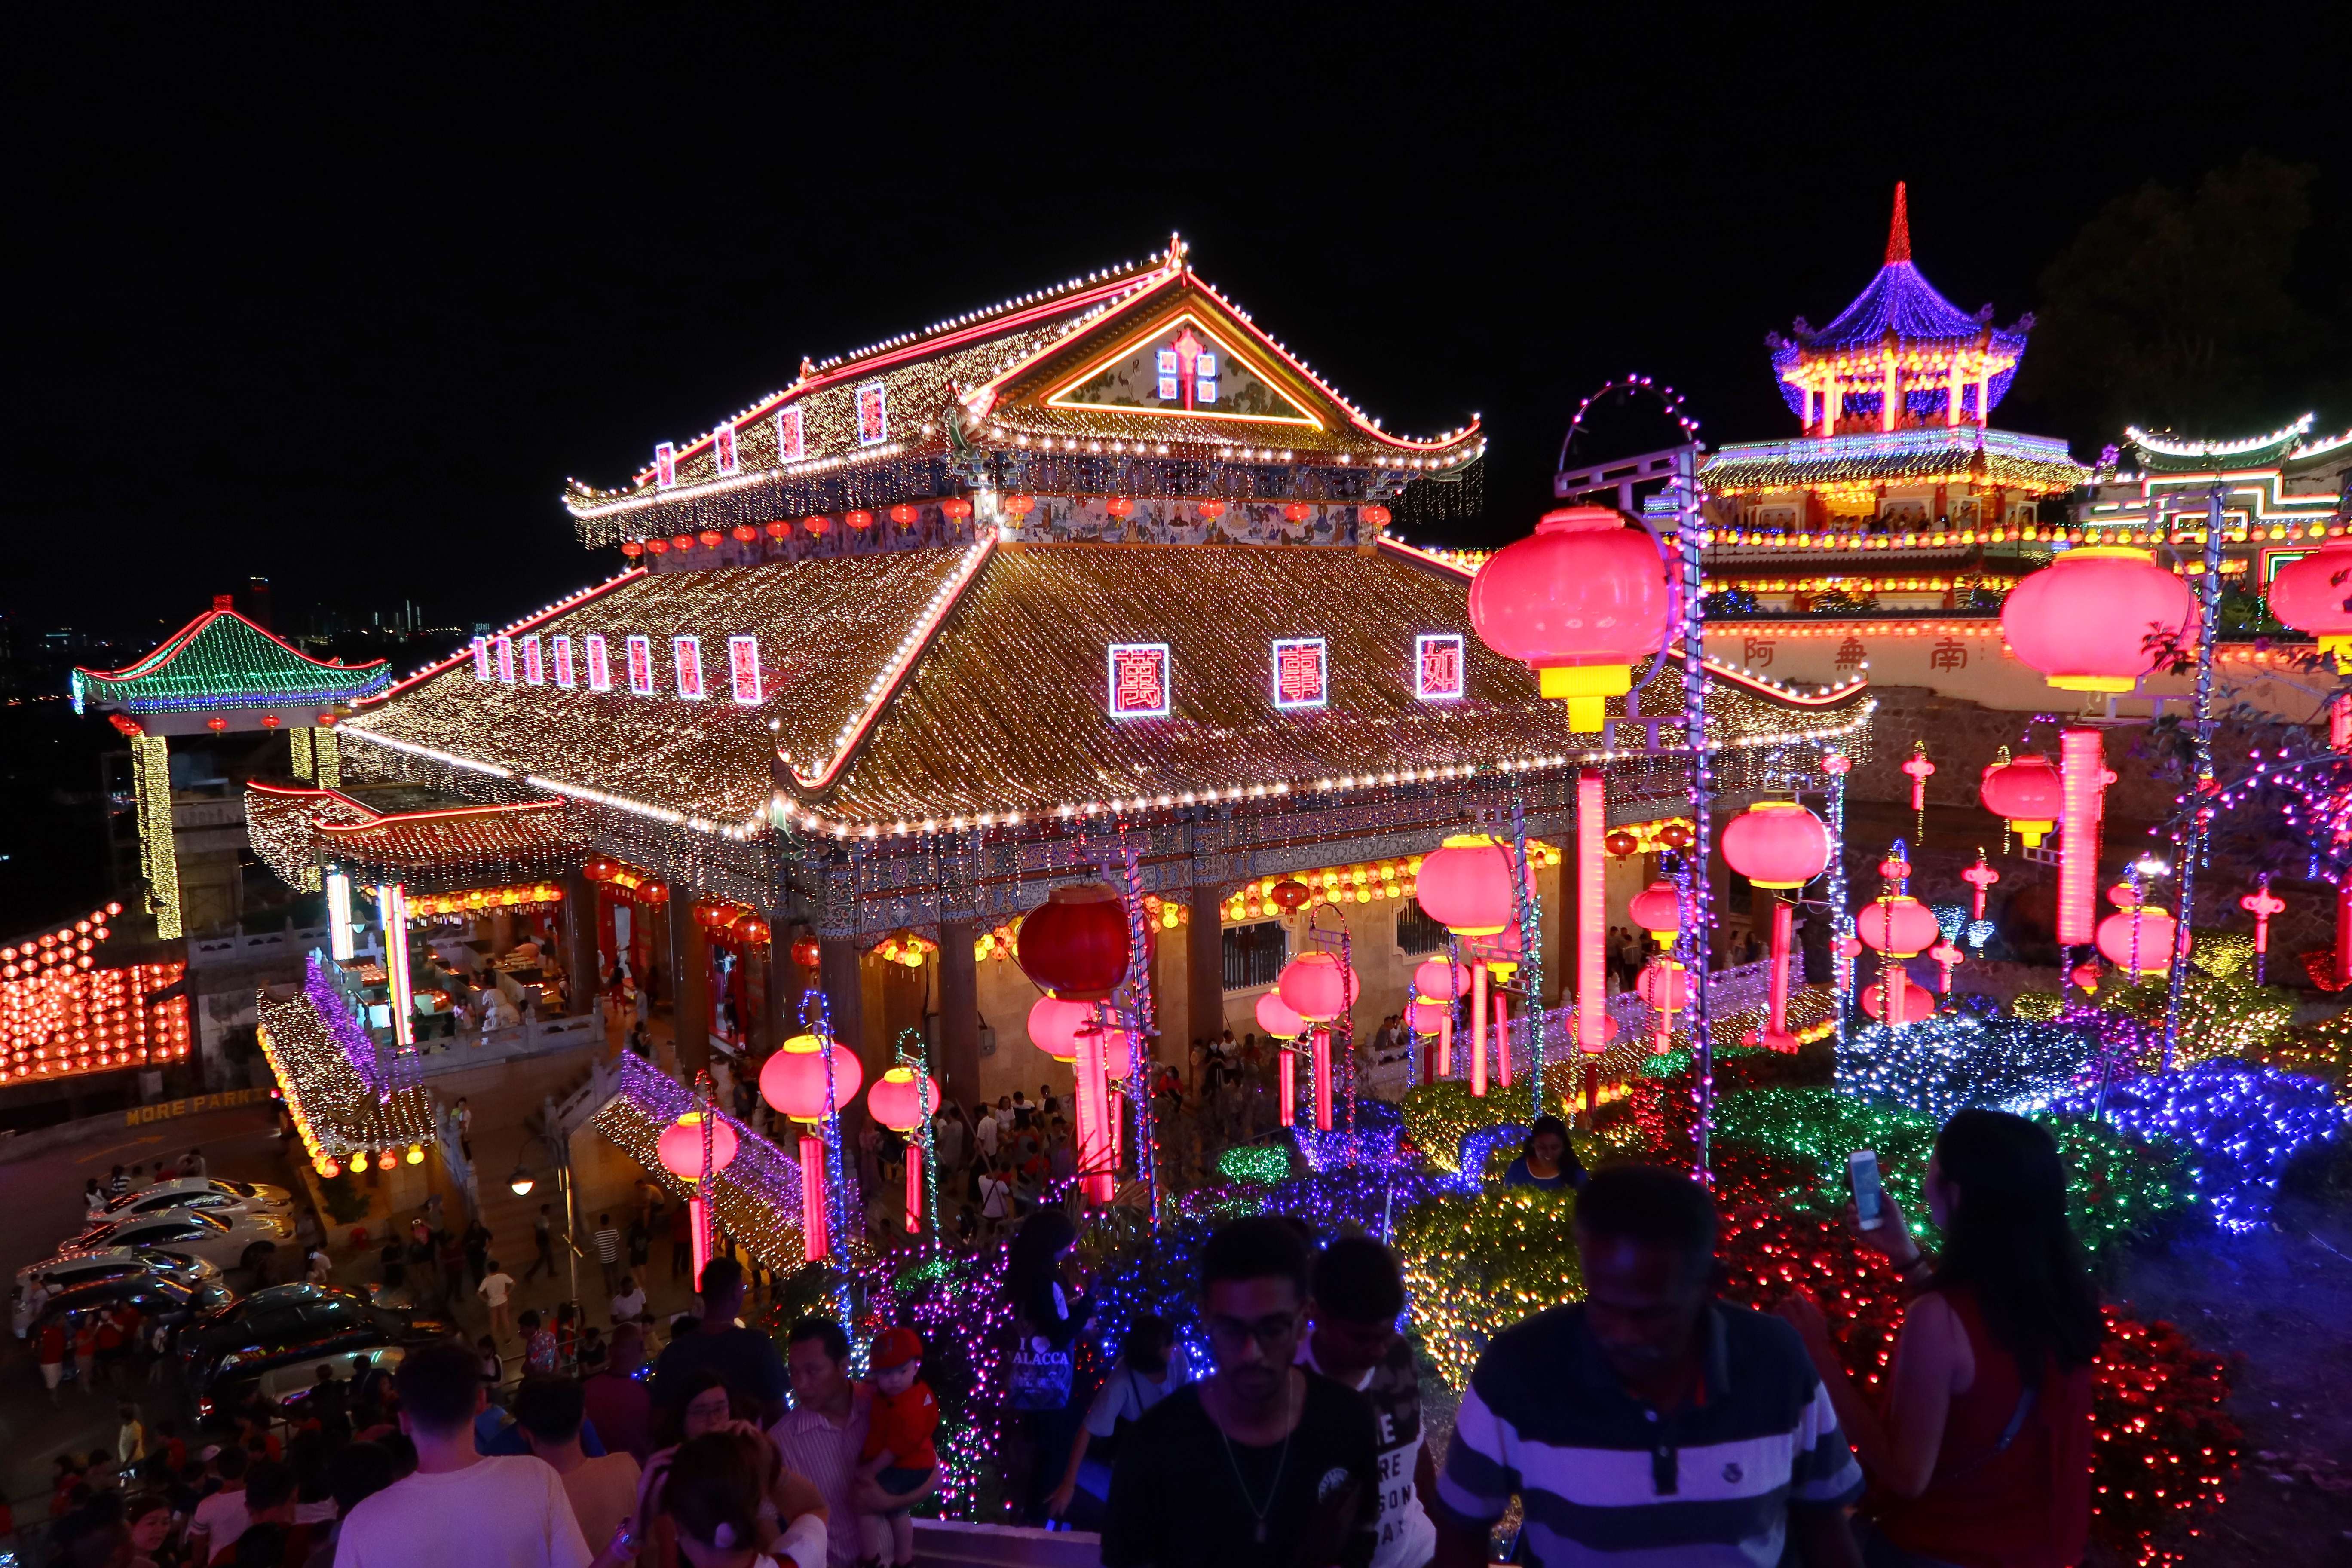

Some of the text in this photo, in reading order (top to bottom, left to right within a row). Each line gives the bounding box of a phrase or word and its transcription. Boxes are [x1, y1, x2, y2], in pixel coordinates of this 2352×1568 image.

[1114, 640, 1458, 710] 萬 事 如
[1019, 1337, 1026, 1351] I
